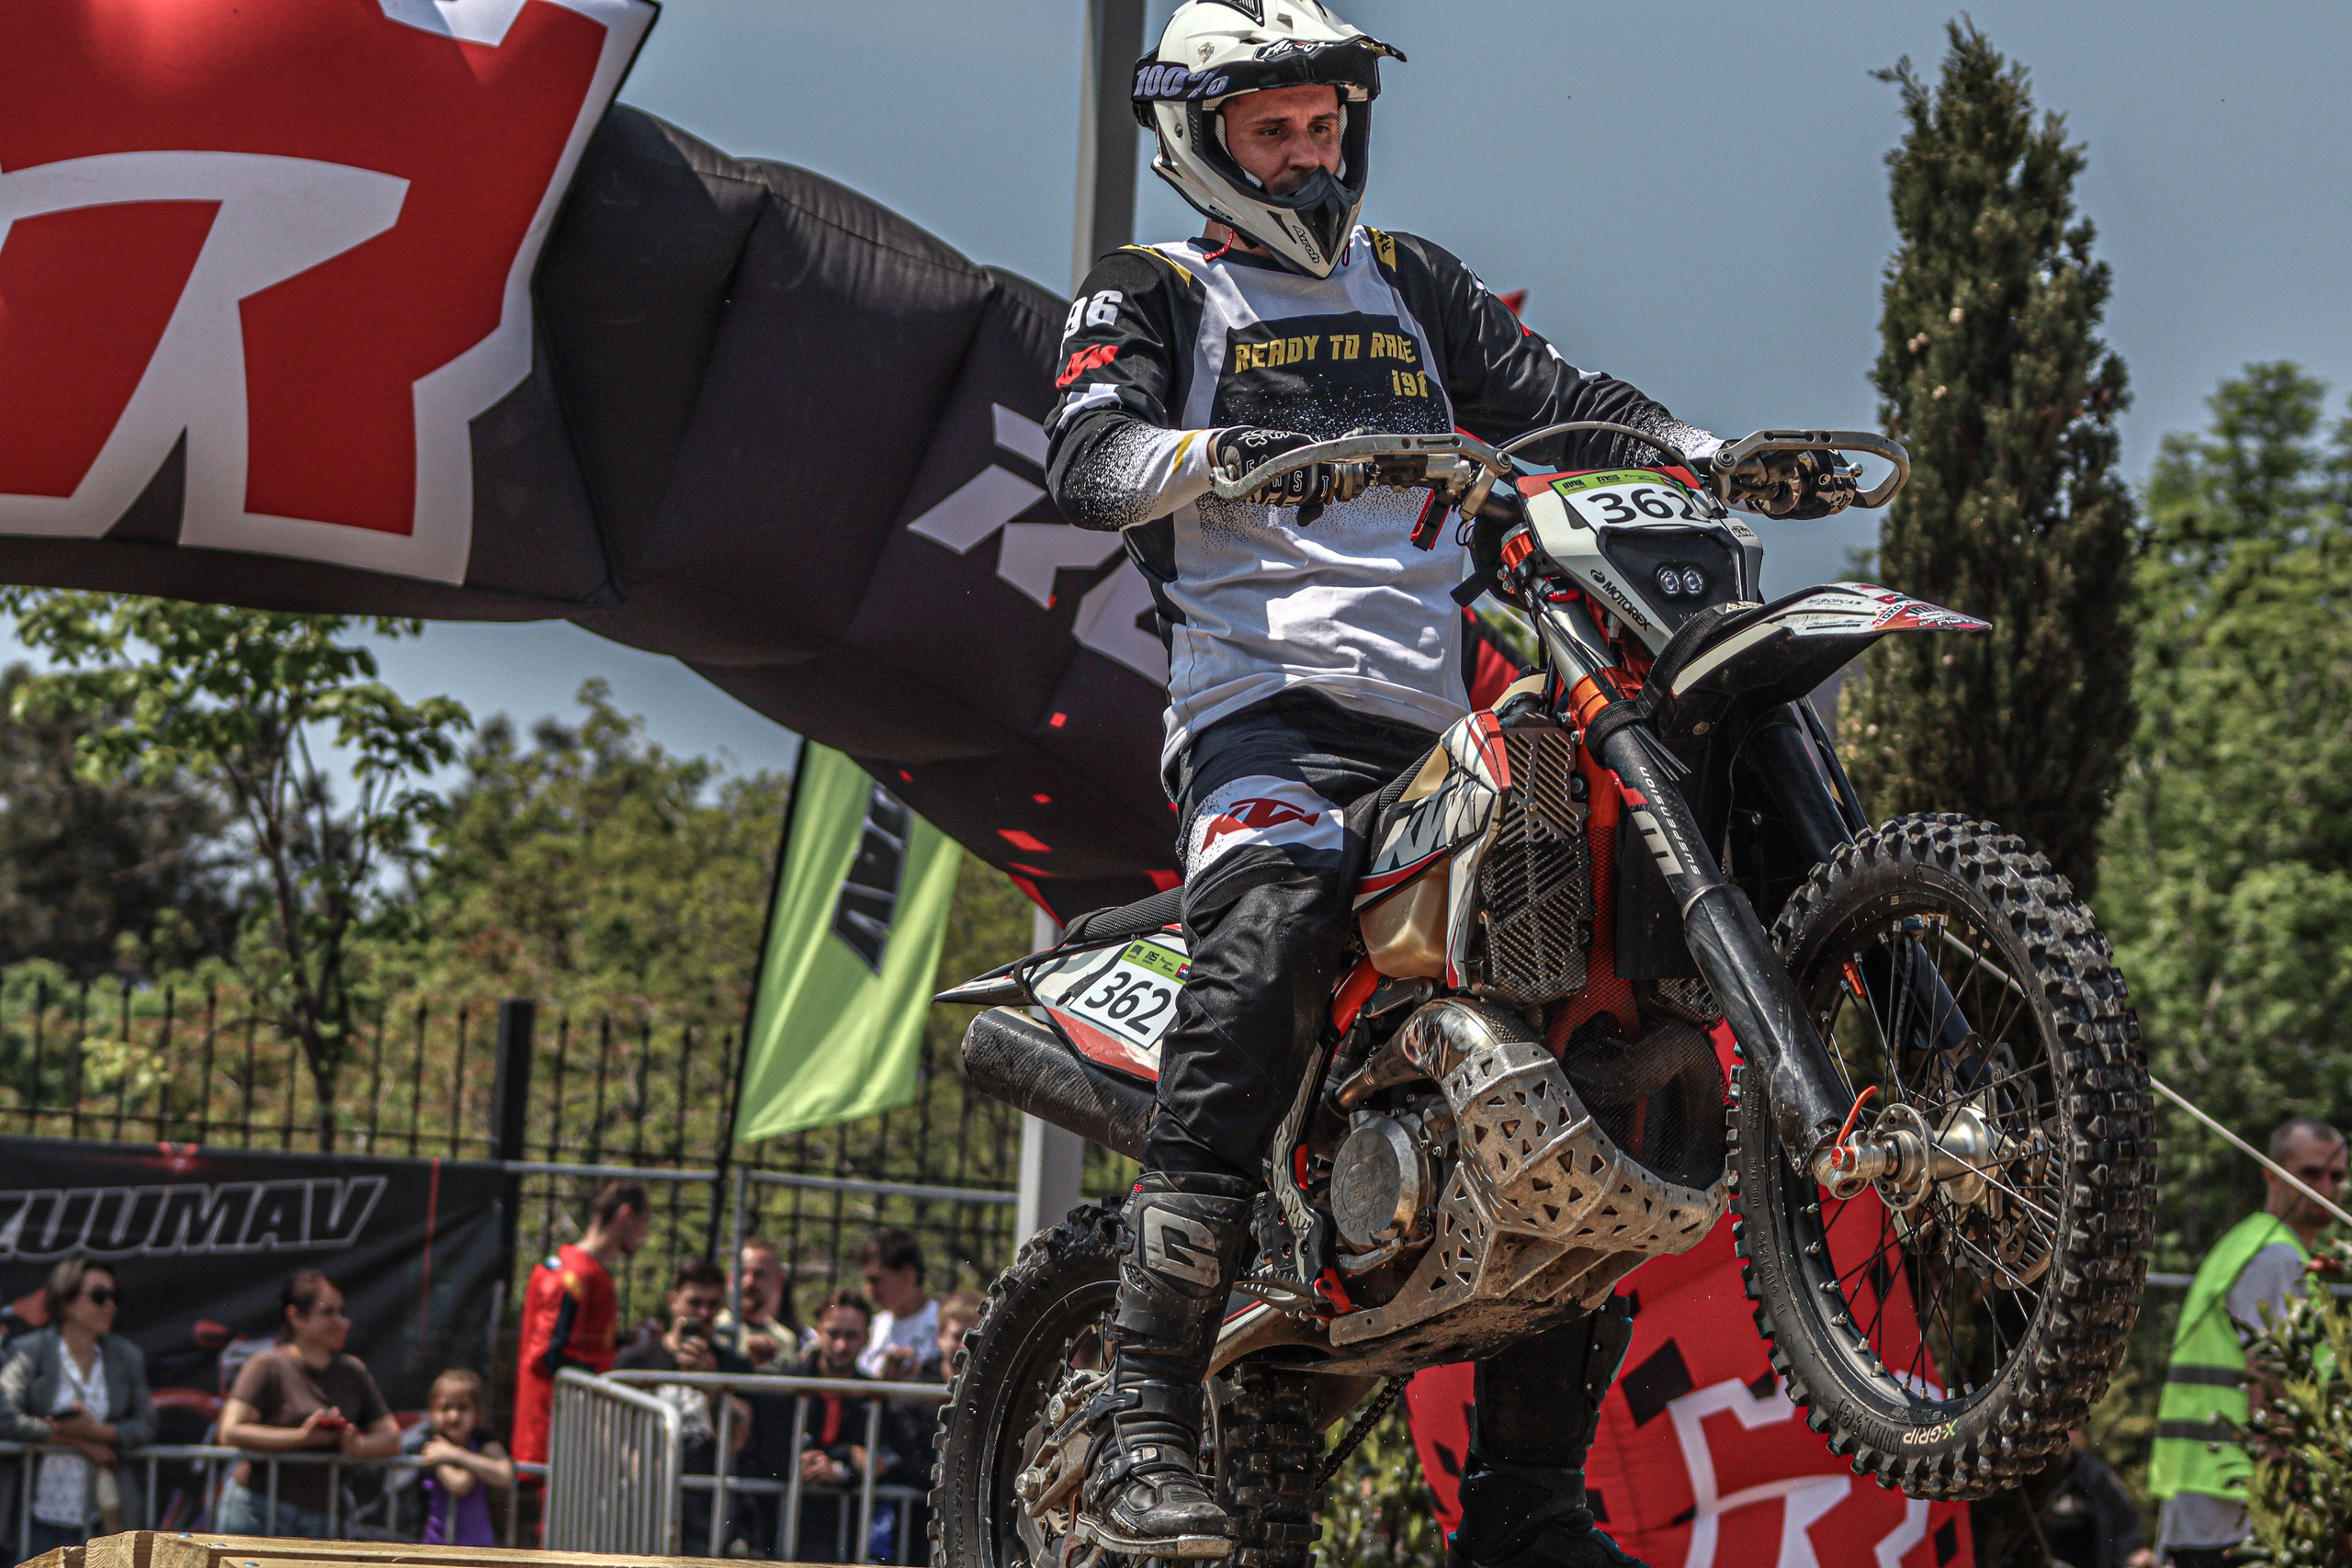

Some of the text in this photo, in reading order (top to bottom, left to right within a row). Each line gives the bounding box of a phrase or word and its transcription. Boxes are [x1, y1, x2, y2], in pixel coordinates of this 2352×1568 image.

[1132, 64, 1229, 99] 100%
[1235, 335, 1320, 374] READY
[1329, 334, 1360, 359] TO
[1587, 488, 1712, 524] 362
[1602, 581, 1653, 632] MOTOREX
[1639, 766, 1701, 875] SUSPENSION
[1084, 971, 1172, 1036] 362
[1903, 1418, 1958, 1445] X-GRIP
